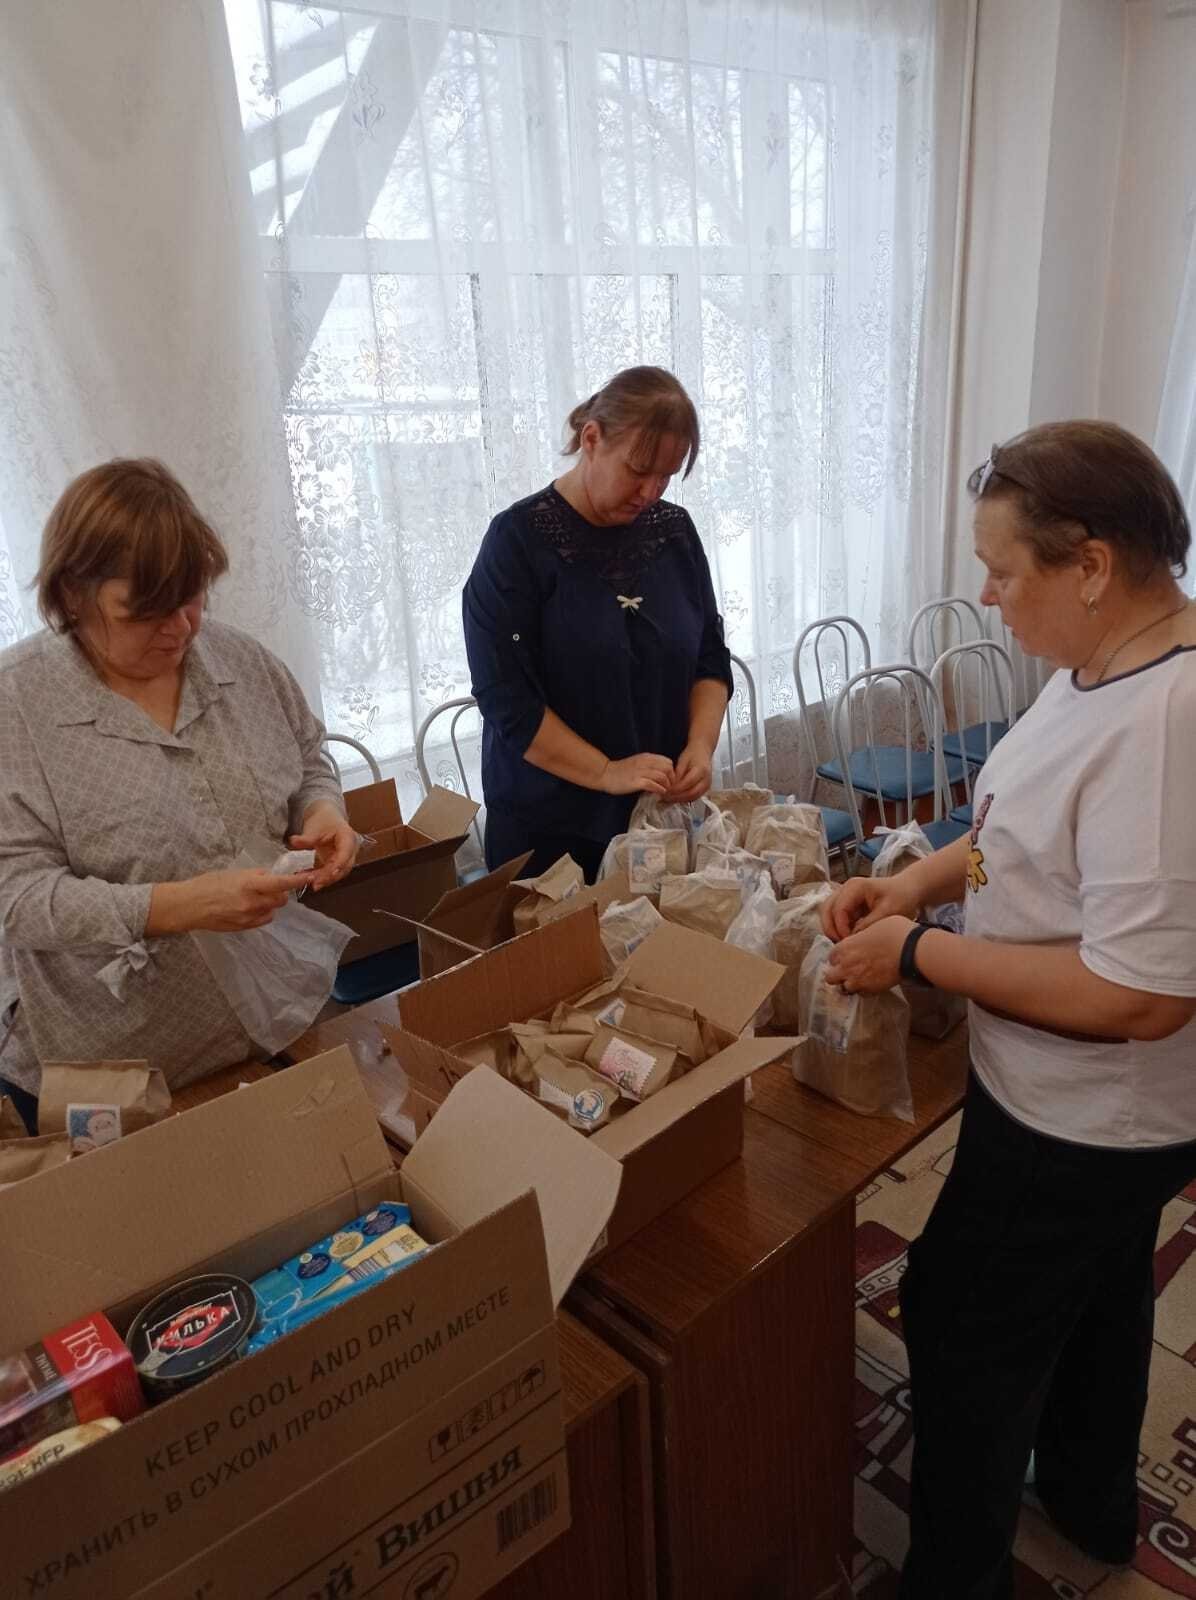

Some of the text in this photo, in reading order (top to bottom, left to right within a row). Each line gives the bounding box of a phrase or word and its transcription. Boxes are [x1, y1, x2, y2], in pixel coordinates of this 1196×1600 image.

[60, 1321, 113, 1371] TESS
[155, 1305, 230, 1346] КИЛЬКА
[24, 1285, 512, 1595] ХРАНИТЬ В СУХОМ ПРОХЛАДНОМ МЕСТЕ
[144, 1303, 417, 1478] KEEP COOL AND DRY
[374, 1444, 523, 1569] Вишня
